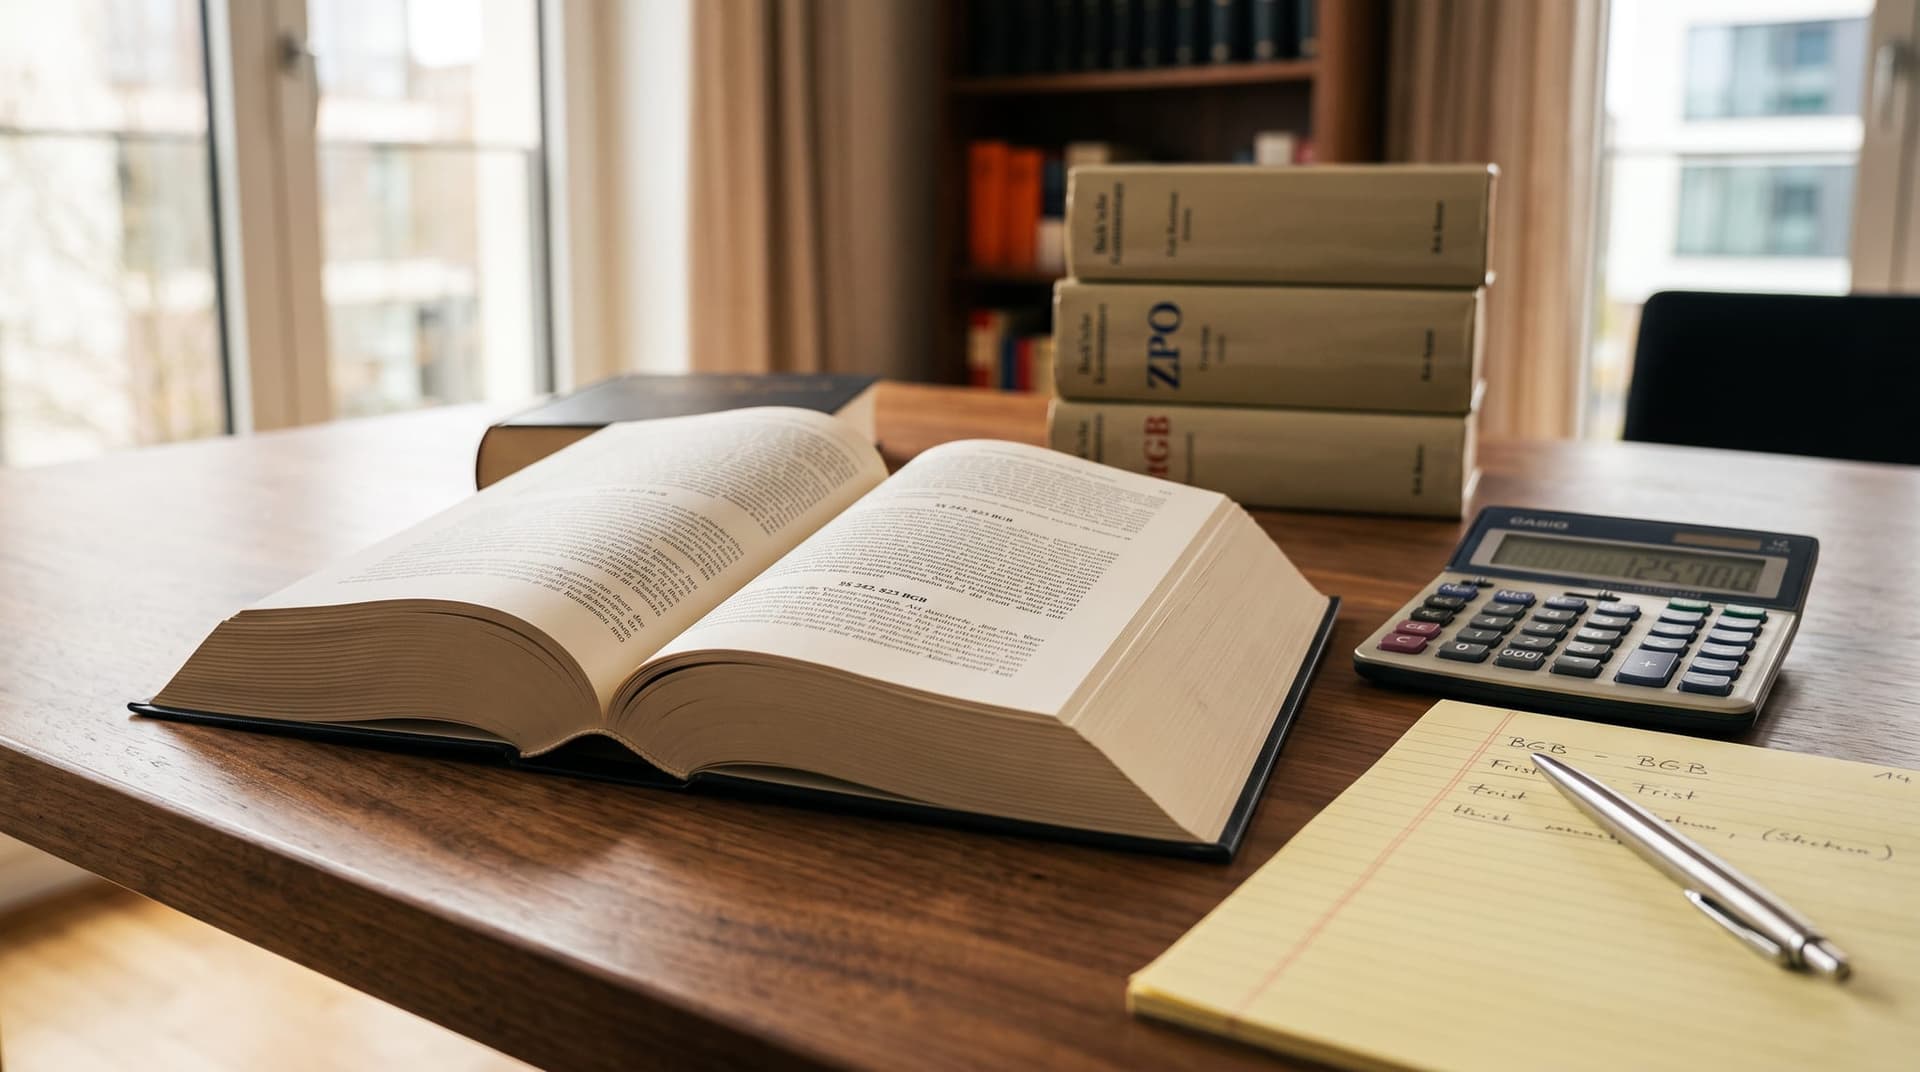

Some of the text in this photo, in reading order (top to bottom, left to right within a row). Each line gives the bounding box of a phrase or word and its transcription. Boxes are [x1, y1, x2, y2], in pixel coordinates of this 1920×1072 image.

[1147, 301, 1182, 391] ZPO
[1509, 517, 1569, 530] CASIO
[902, 593, 928, 603] BGB
[1484, 617, 1498, 625] 4
[1536, 623, 1549, 631] 5
[1396, 636, 1412, 644] C
[1455, 642, 1469, 651] 0
[1502, 649, 1538, 660] 000
[1507, 736, 1568, 755] BGB
[1637, 755, 1708, 775] BGB
[1632, 781, 1697, 801] Frist
